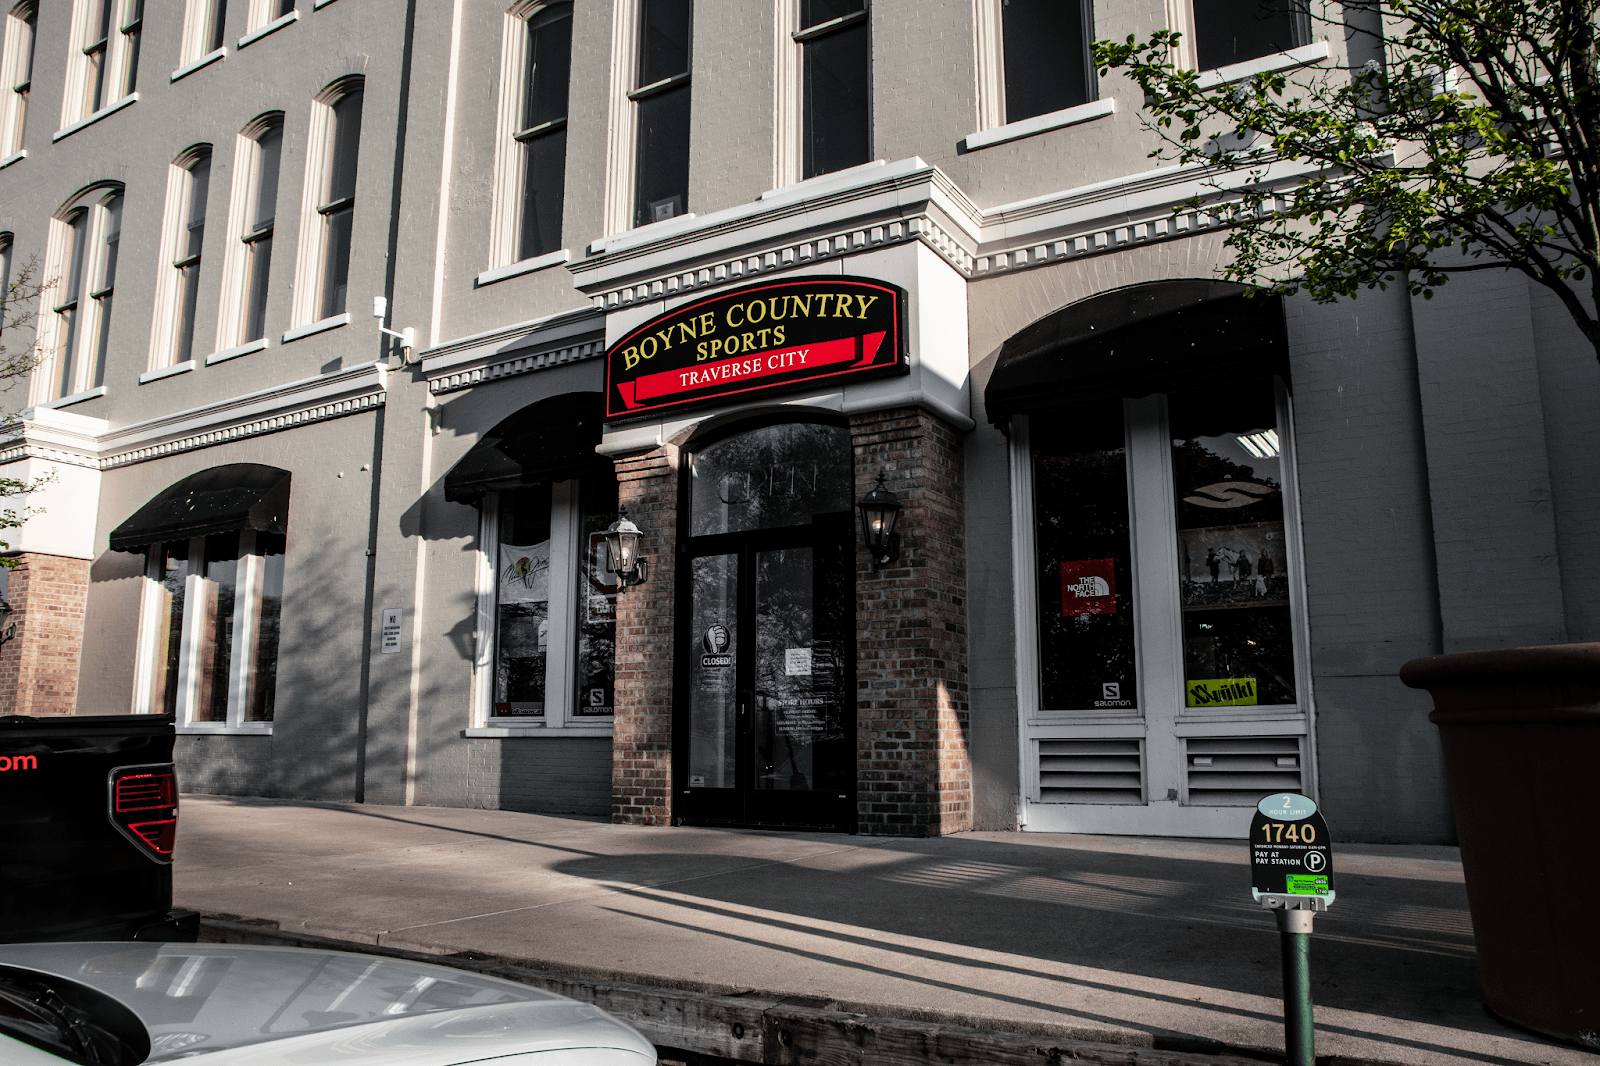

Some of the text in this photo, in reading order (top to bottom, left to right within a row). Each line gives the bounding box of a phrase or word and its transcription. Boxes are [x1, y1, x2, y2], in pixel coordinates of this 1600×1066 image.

[621, 293, 879, 371] BOYNE COUNTRY
[696, 325, 786, 361] SPORTS
[679, 349, 810, 387] TRAVERSE CITY
[1078, 576, 1095, 584] THE
[1067, 583, 1095, 592] NORTH
[1074, 590, 1095, 598] FACE
[702, 656, 731, 665] CLOSED!
[778, 698, 824, 707] STORE HOURS
[1093, 699, 1132, 707] salomon
[582, 706, 612, 714] salomon
[1282, 795, 1292, 809] 2
[1261, 823, 1316, 844] 1740
[1254, 850, 1268, 858] PAY
[1255, 857, 1301, 866] PAY STATION
